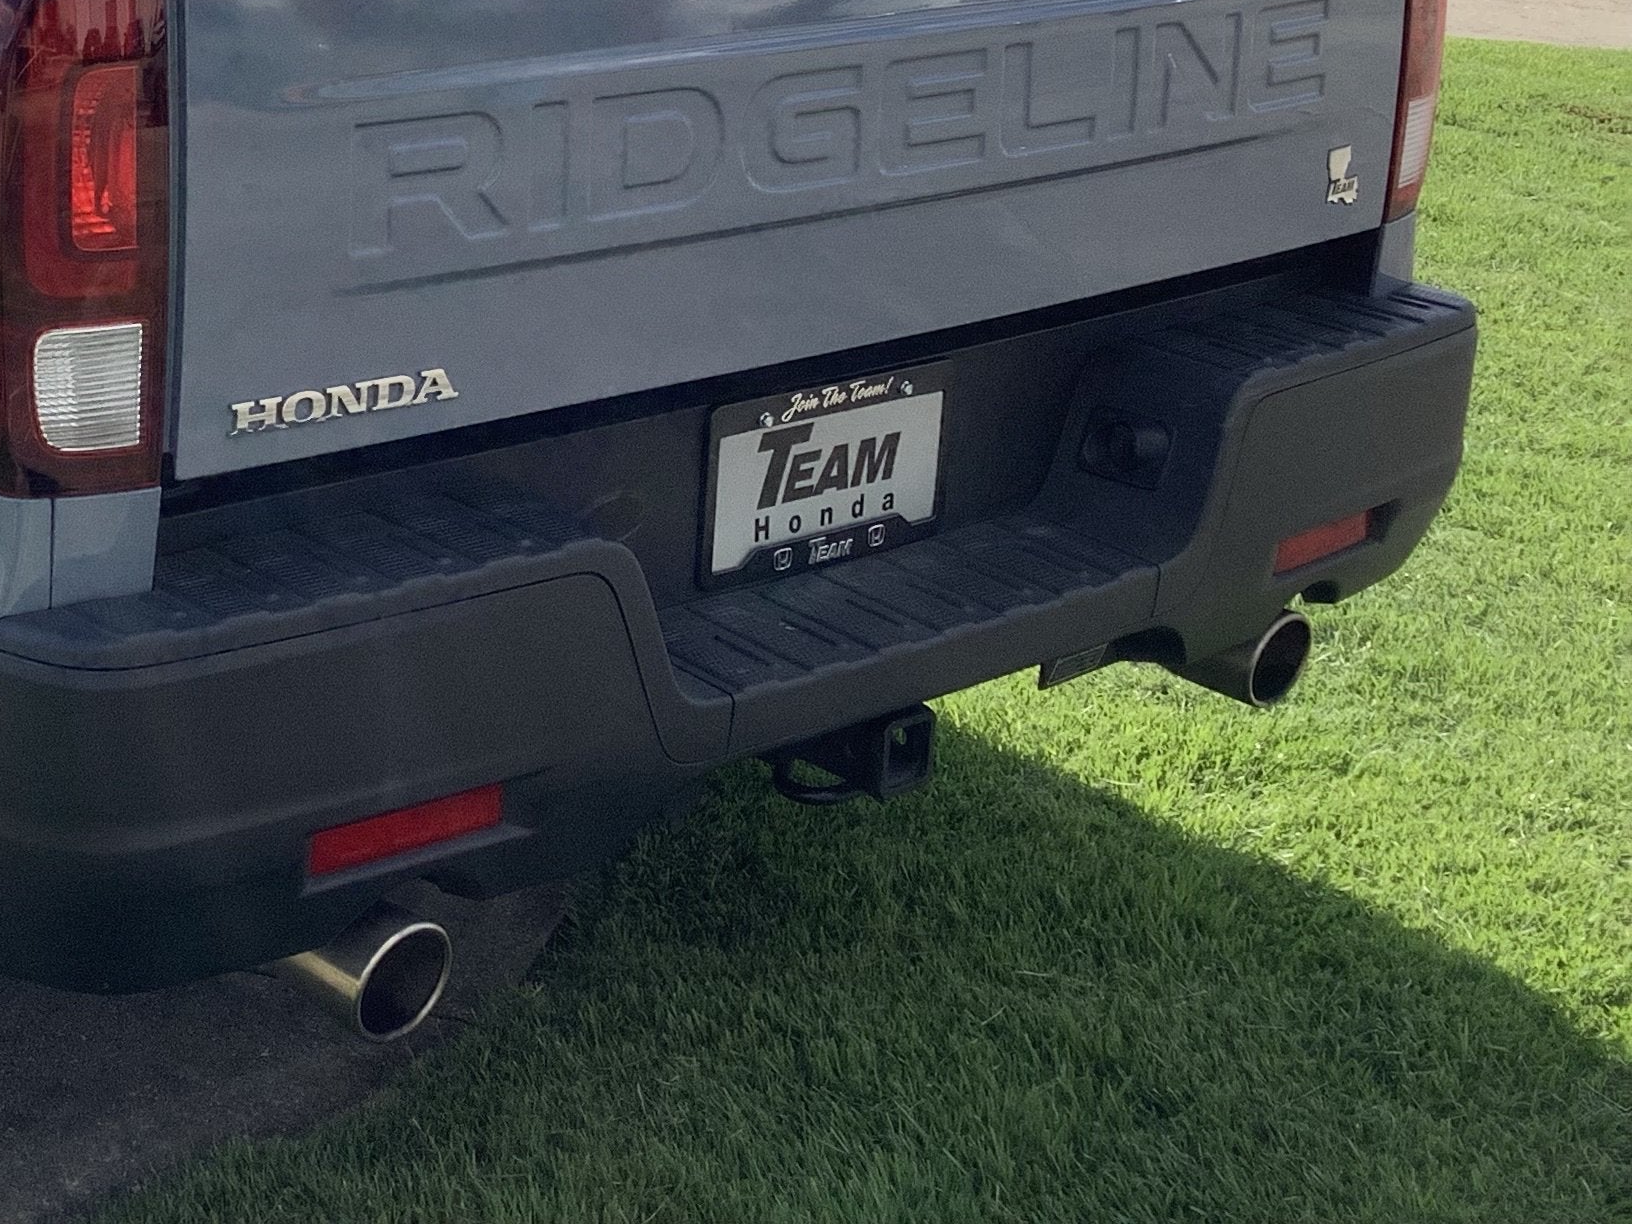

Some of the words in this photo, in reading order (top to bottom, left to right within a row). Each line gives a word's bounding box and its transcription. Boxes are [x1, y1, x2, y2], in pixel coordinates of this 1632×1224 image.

[230, 368, 459, 436] HONDA
[781, 392, 820, 422] Join
[822, 386, 847, 407] The
[850, 376, 895, 401] Team!
[756, 421, 902, 510] TEAM
[754, 492, 895, 543] Honda
[808, 537, 854, 565] TEAM
